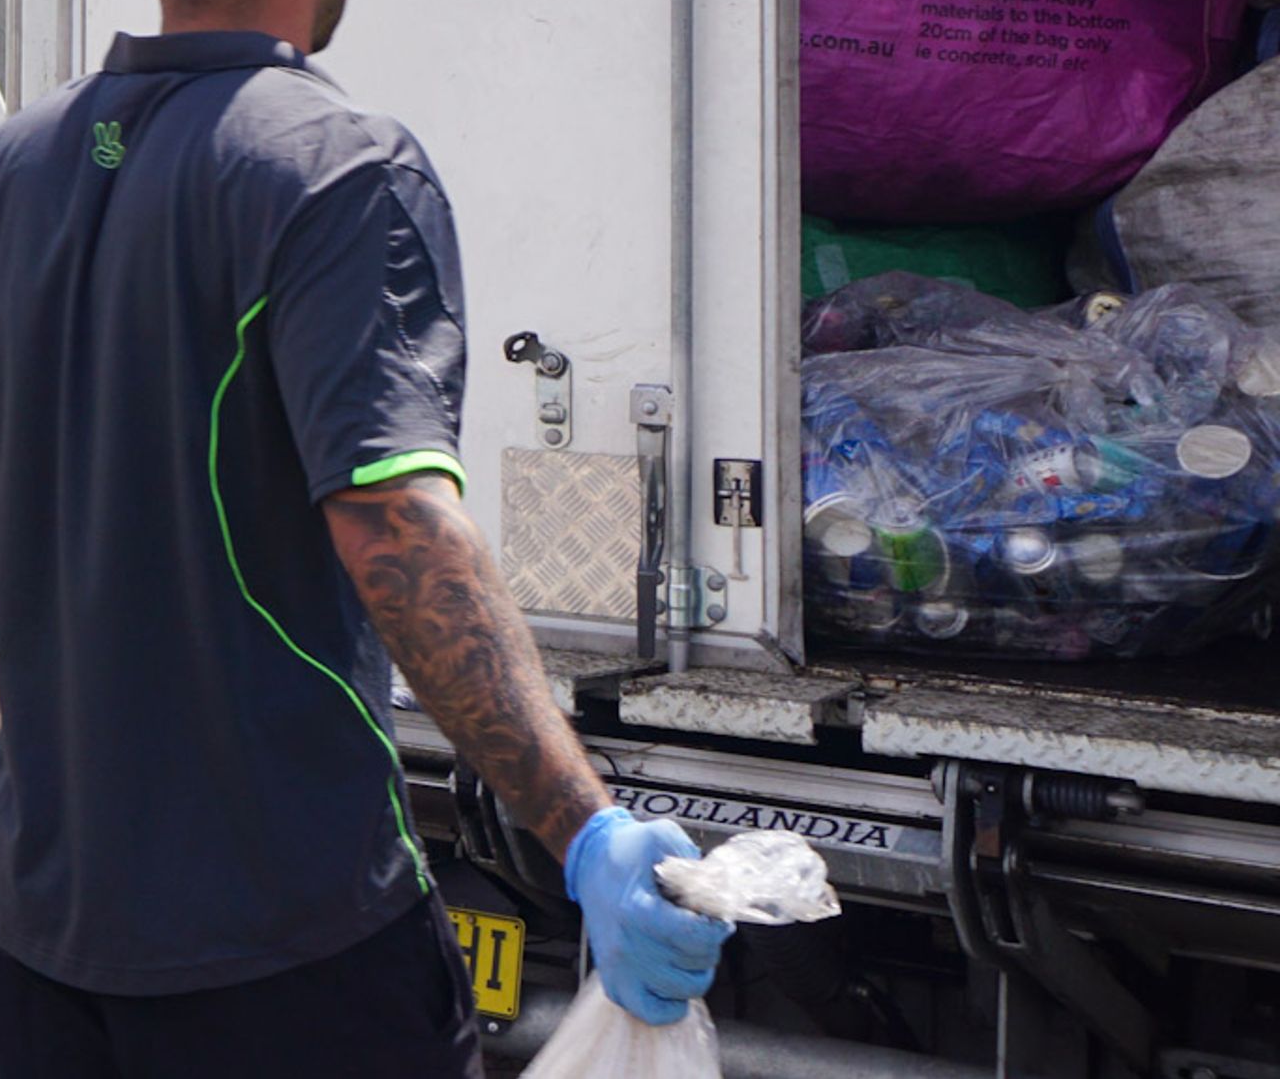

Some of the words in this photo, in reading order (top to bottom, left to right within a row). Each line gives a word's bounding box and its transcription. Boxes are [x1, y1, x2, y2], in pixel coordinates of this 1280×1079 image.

[921, 3, 1005, 21] materials
[1009, 7, 1029, 22] to
[1035, 8, 1062, 25] the
[1067, 10, 1131, 31] bottom
[918, 22, 973, 42] 20cm
[977, 26, 998, 42] of
[1002, 28, 1030, 45] the
[1035, 30, 1069, 51] bag
[915, 43, 932, 58] ie
[1025, 52, 1057, 69] soil
[611, 787, 892, 851] HOLLANDIA
